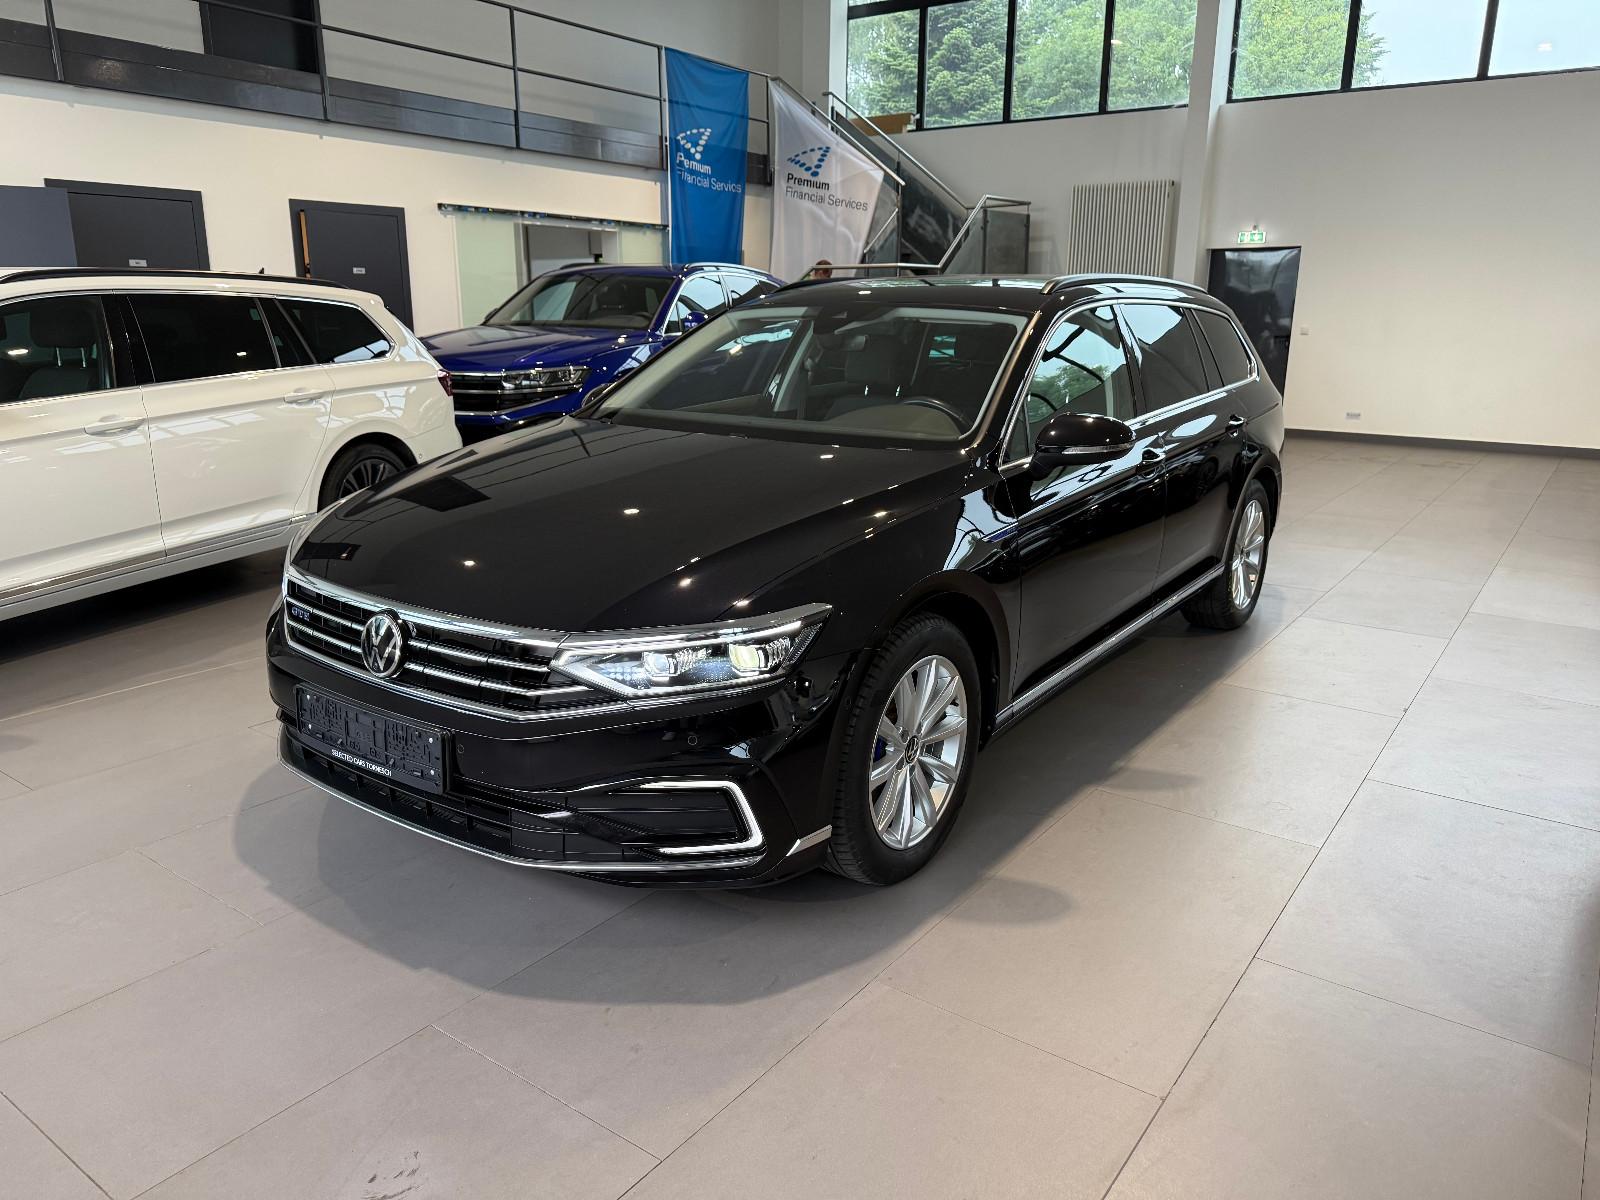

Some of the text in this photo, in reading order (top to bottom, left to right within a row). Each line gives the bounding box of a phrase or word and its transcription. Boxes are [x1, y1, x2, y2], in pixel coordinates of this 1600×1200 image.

[676, 151, 712, 175] Pemium
[786, 172, 830, 191] Premium
[785, 186, 869, 212] Financial Services
[331, 748, 354, 763] SELECTED
[353, 757, 366, 767] CARS
